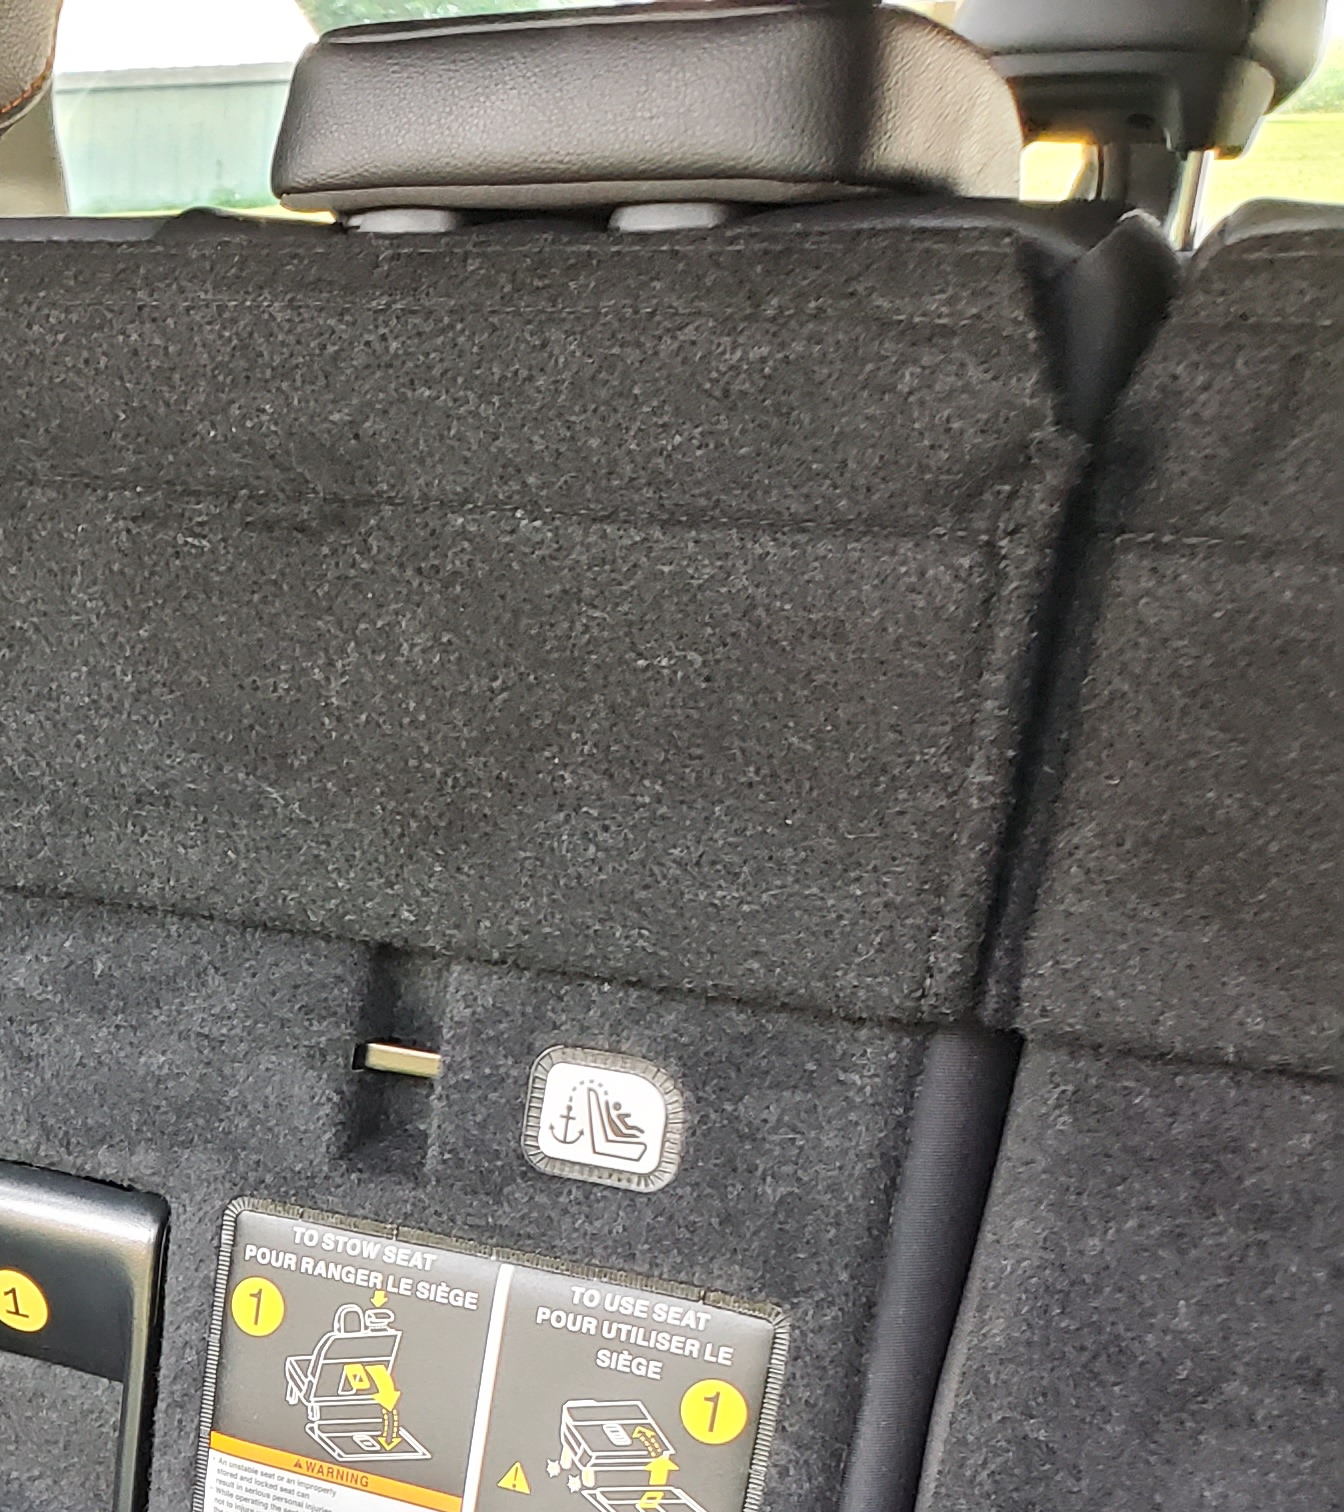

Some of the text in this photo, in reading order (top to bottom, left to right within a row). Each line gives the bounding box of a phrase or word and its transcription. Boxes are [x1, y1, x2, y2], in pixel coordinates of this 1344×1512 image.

[292, 1225, 438, 1270] TO STOW SEAT
[244, 1244, 478, 1309] POUR RANGER LE SIÈGE
[570, 1285, 711, 1330] TO USE SEAT
[536, 1306, 733, 1365] POUR UTILISER LE
[596, 1349, 662, 1379] SIÈGE
[305, 1460, 368, 1487] WARNING
